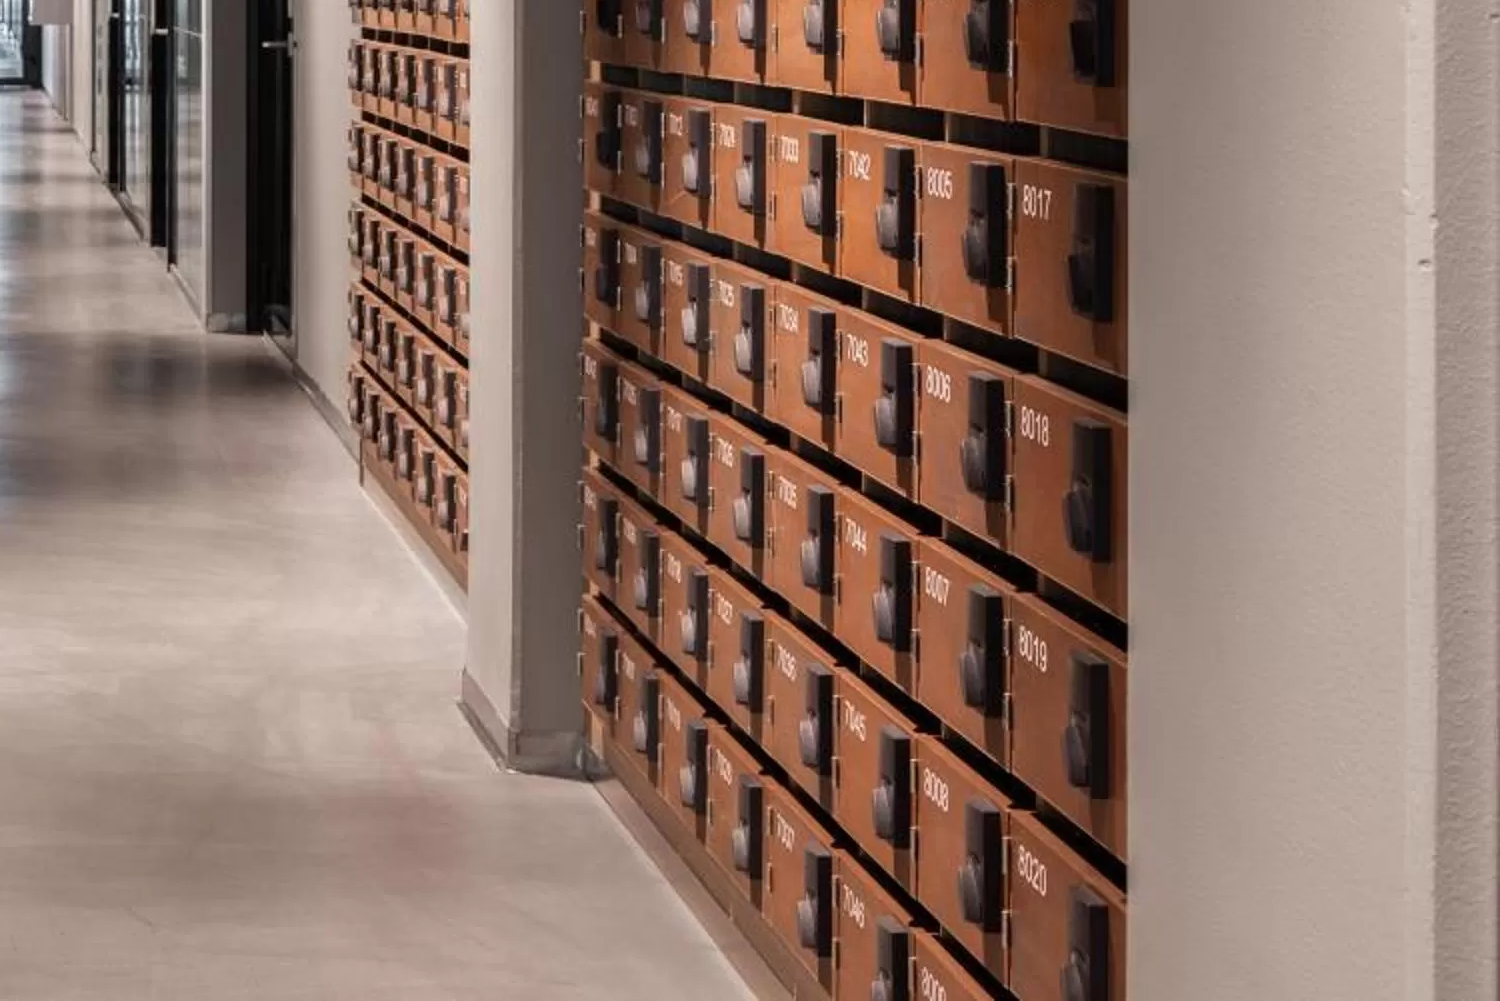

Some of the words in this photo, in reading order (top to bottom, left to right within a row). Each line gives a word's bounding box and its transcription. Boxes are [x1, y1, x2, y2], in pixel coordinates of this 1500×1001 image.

[1022, 183, 1052, 220] 8017
[845, 332, 870, 368] 7043
[1021, 405, 1050, 448] 8018
[924, 565, 950, 607] 8007
[1017, 624, 1048, 673] 8019
[843, 700, 869, 742] 7045
[922, 767, 950, 813] 8008
[1017, 843, 1048, 897] 8020
